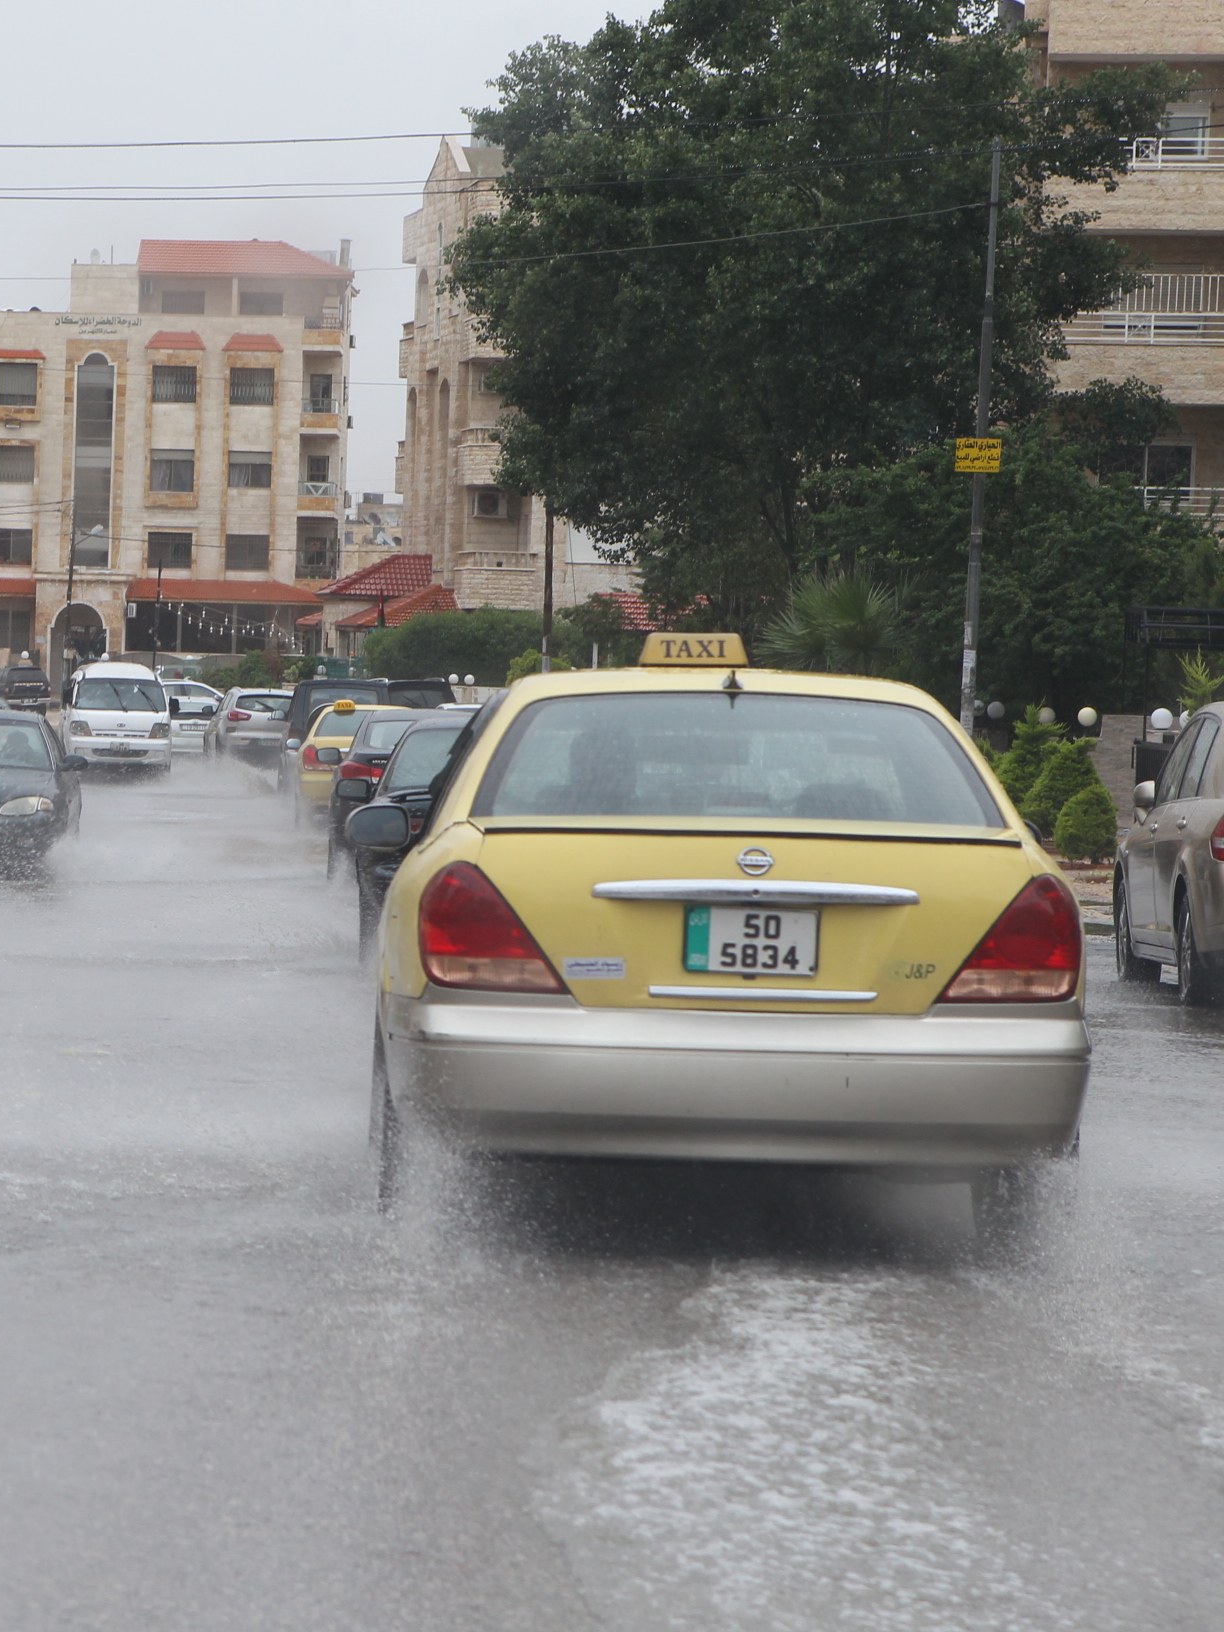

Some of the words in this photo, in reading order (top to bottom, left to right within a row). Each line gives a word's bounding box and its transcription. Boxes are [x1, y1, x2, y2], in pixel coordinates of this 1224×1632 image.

[89, 316, 116, 327] الخضراء
[116, 316, 142, 327] الدوحة
[660, 639, 727, 659] TAXI
[743, 913, 782, 939] 50
[720, 942, 800, 970] 5834
[905, 963, 936, 979] J&P
